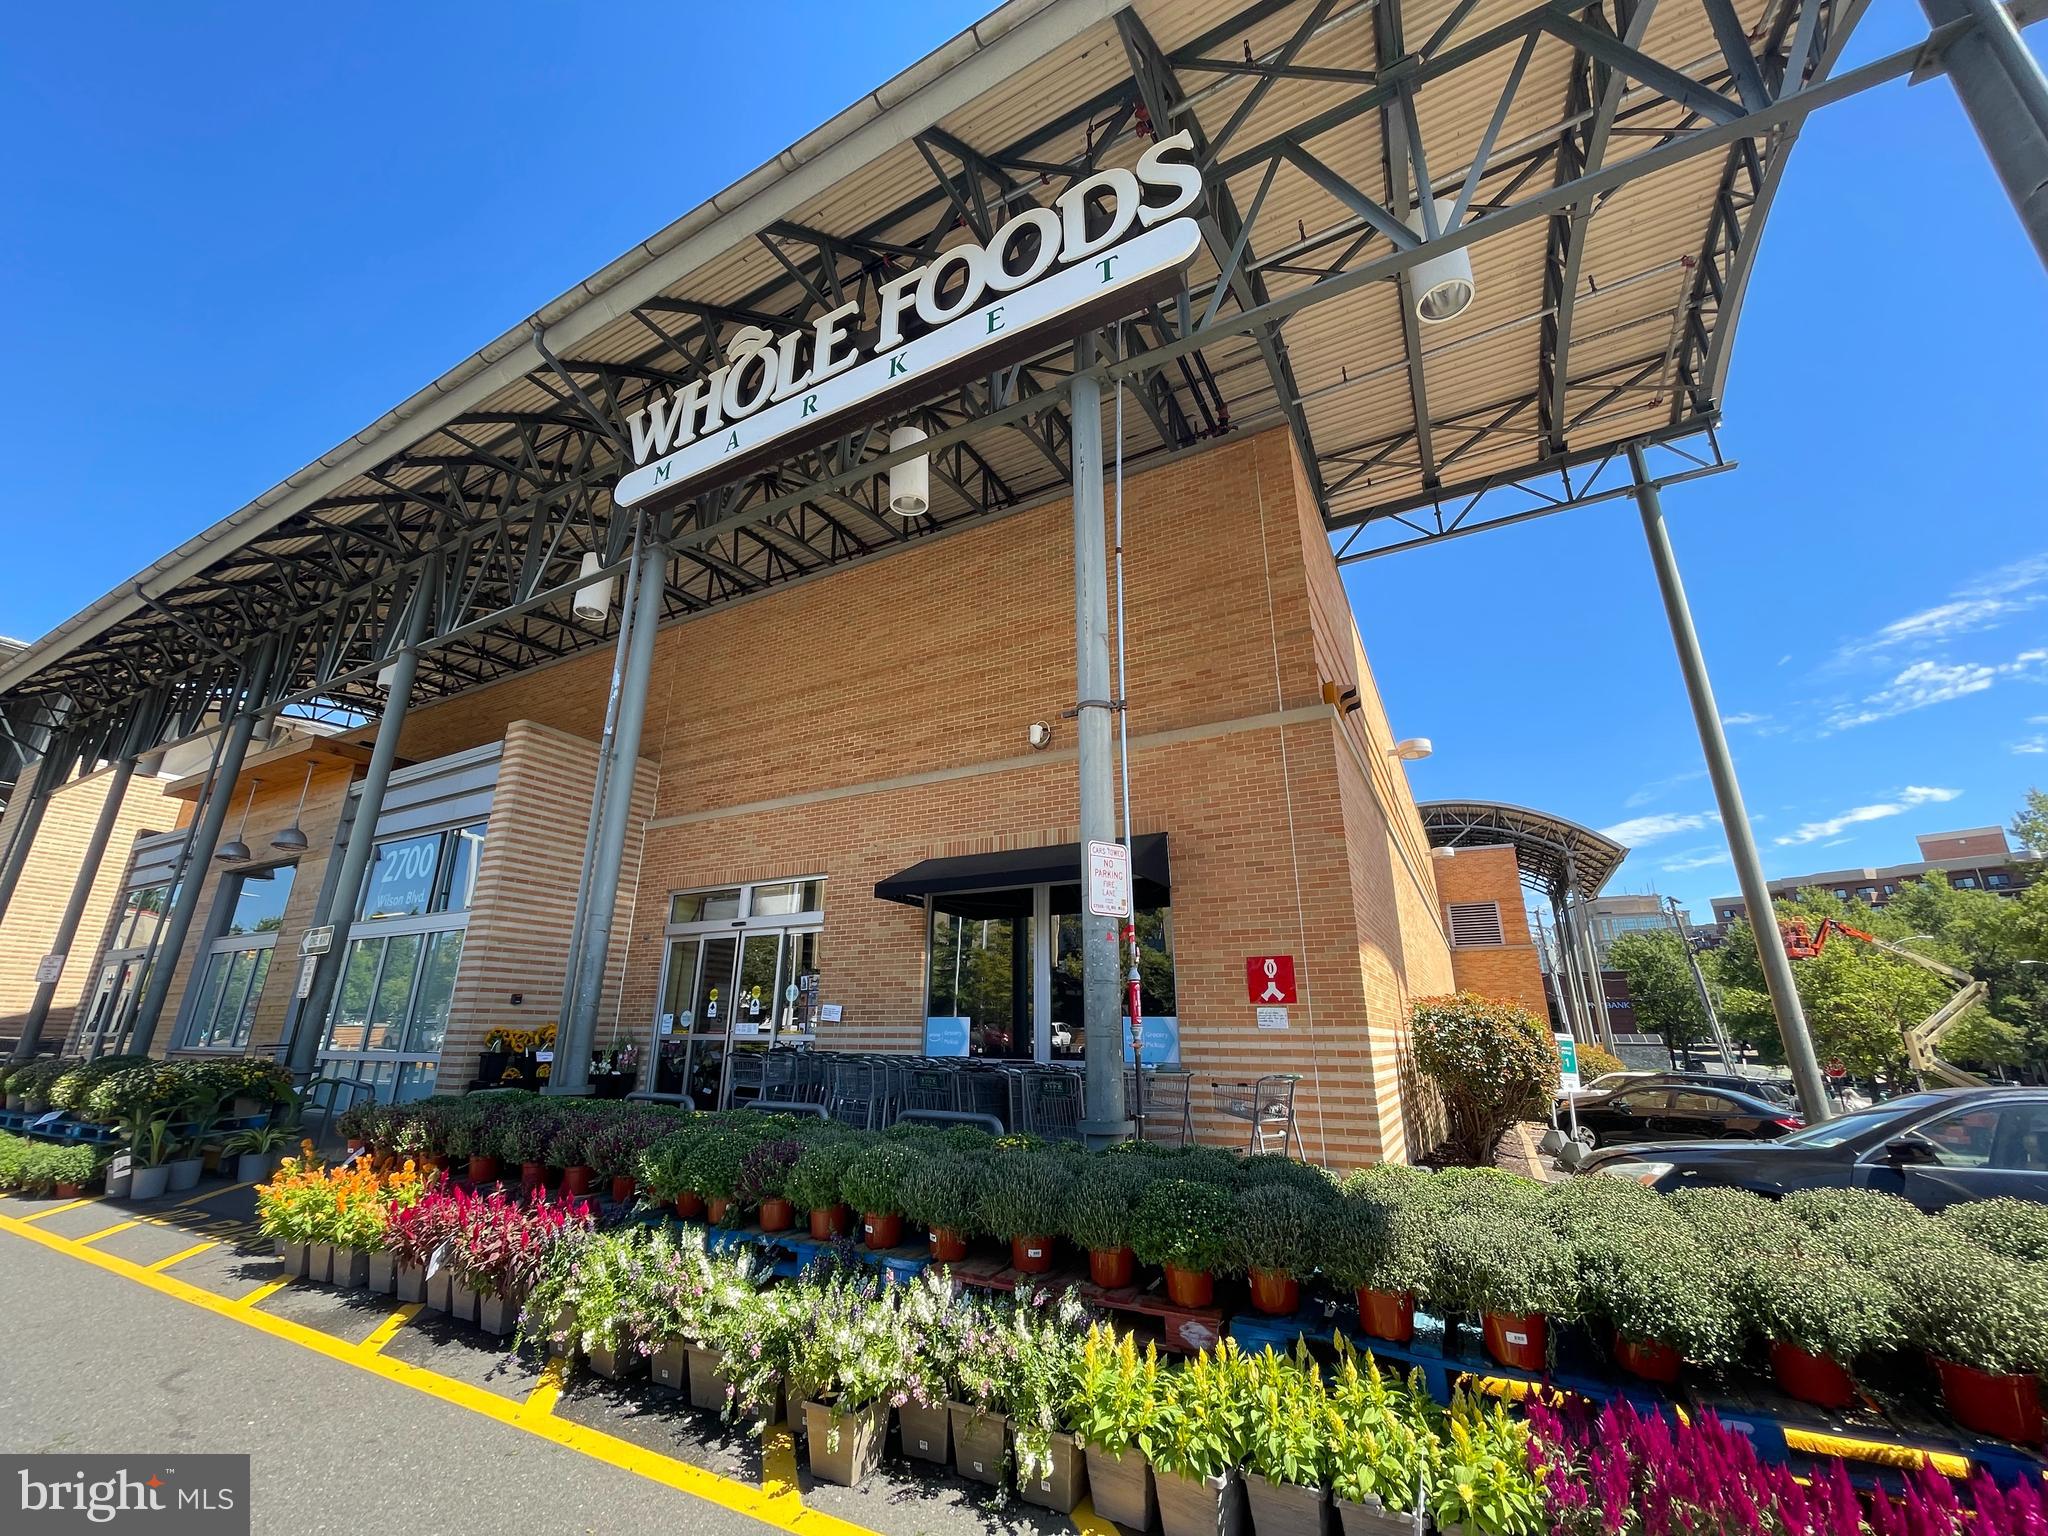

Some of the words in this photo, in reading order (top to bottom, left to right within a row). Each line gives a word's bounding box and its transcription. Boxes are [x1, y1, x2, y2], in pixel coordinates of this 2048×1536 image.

[873, 128, 1203, 354] FOODS
[652, 253, 1119, 486] MARKET
[1092, 846, 1106, 855] CARS
[1107, 847, 1125, 858] TOWED
[381, 843, 434, 883] 2700
[1103, 859, 1114, 869] NO
[1094, 868, 1123, 881] PARKING
[1102, 888, 1116, 897] LANE
[377, 894, 404, 908] Wilson
[1606, 1001, 1631, 1009] BANK
[1145, 1031, 1168, 1040] Grocery
